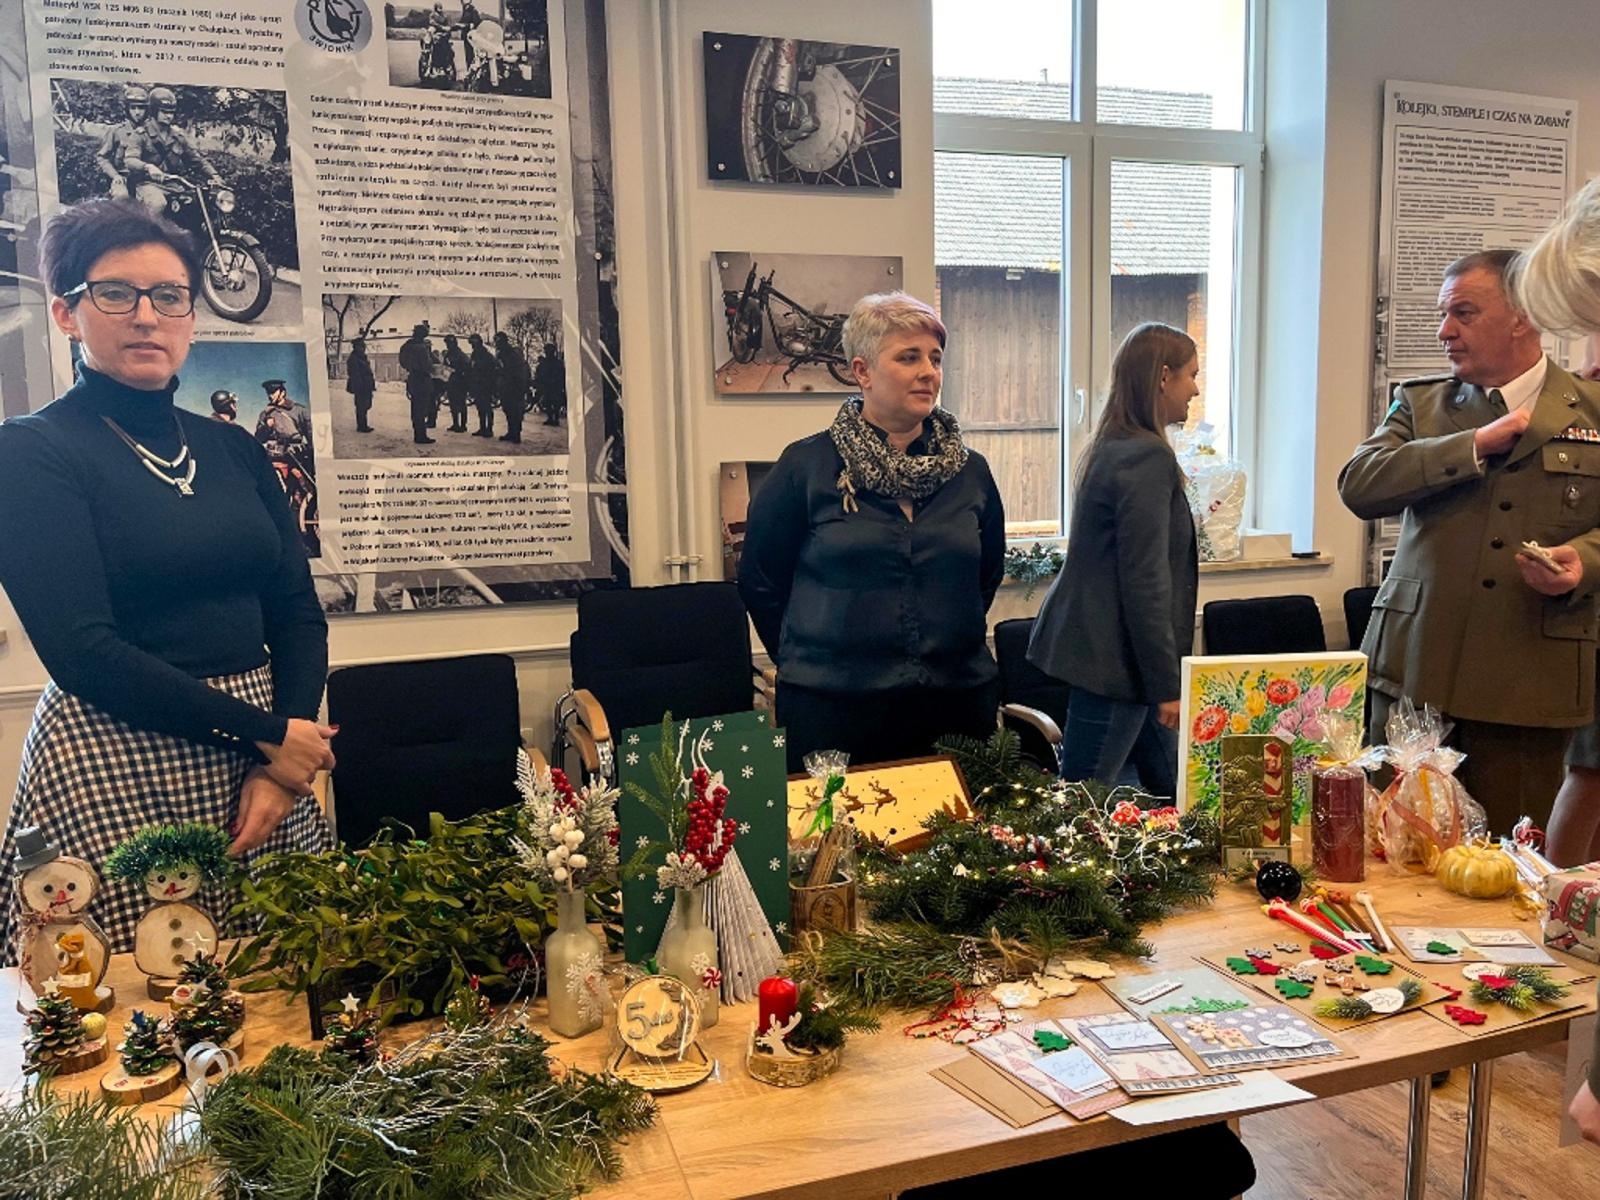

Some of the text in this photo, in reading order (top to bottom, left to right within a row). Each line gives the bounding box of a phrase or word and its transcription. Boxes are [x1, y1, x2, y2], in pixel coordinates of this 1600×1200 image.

[1396, 99, 1440, 118] KOLEJKI,
[1441, 106, 1485, 120] STEMPLE
[1492, 110, 1517, 123] CZAS
[1518, 112, 1532, 124] NA
[1534, 114, 1571, 129] ZMIANY
[626, 1000, 650, 1040] 5
